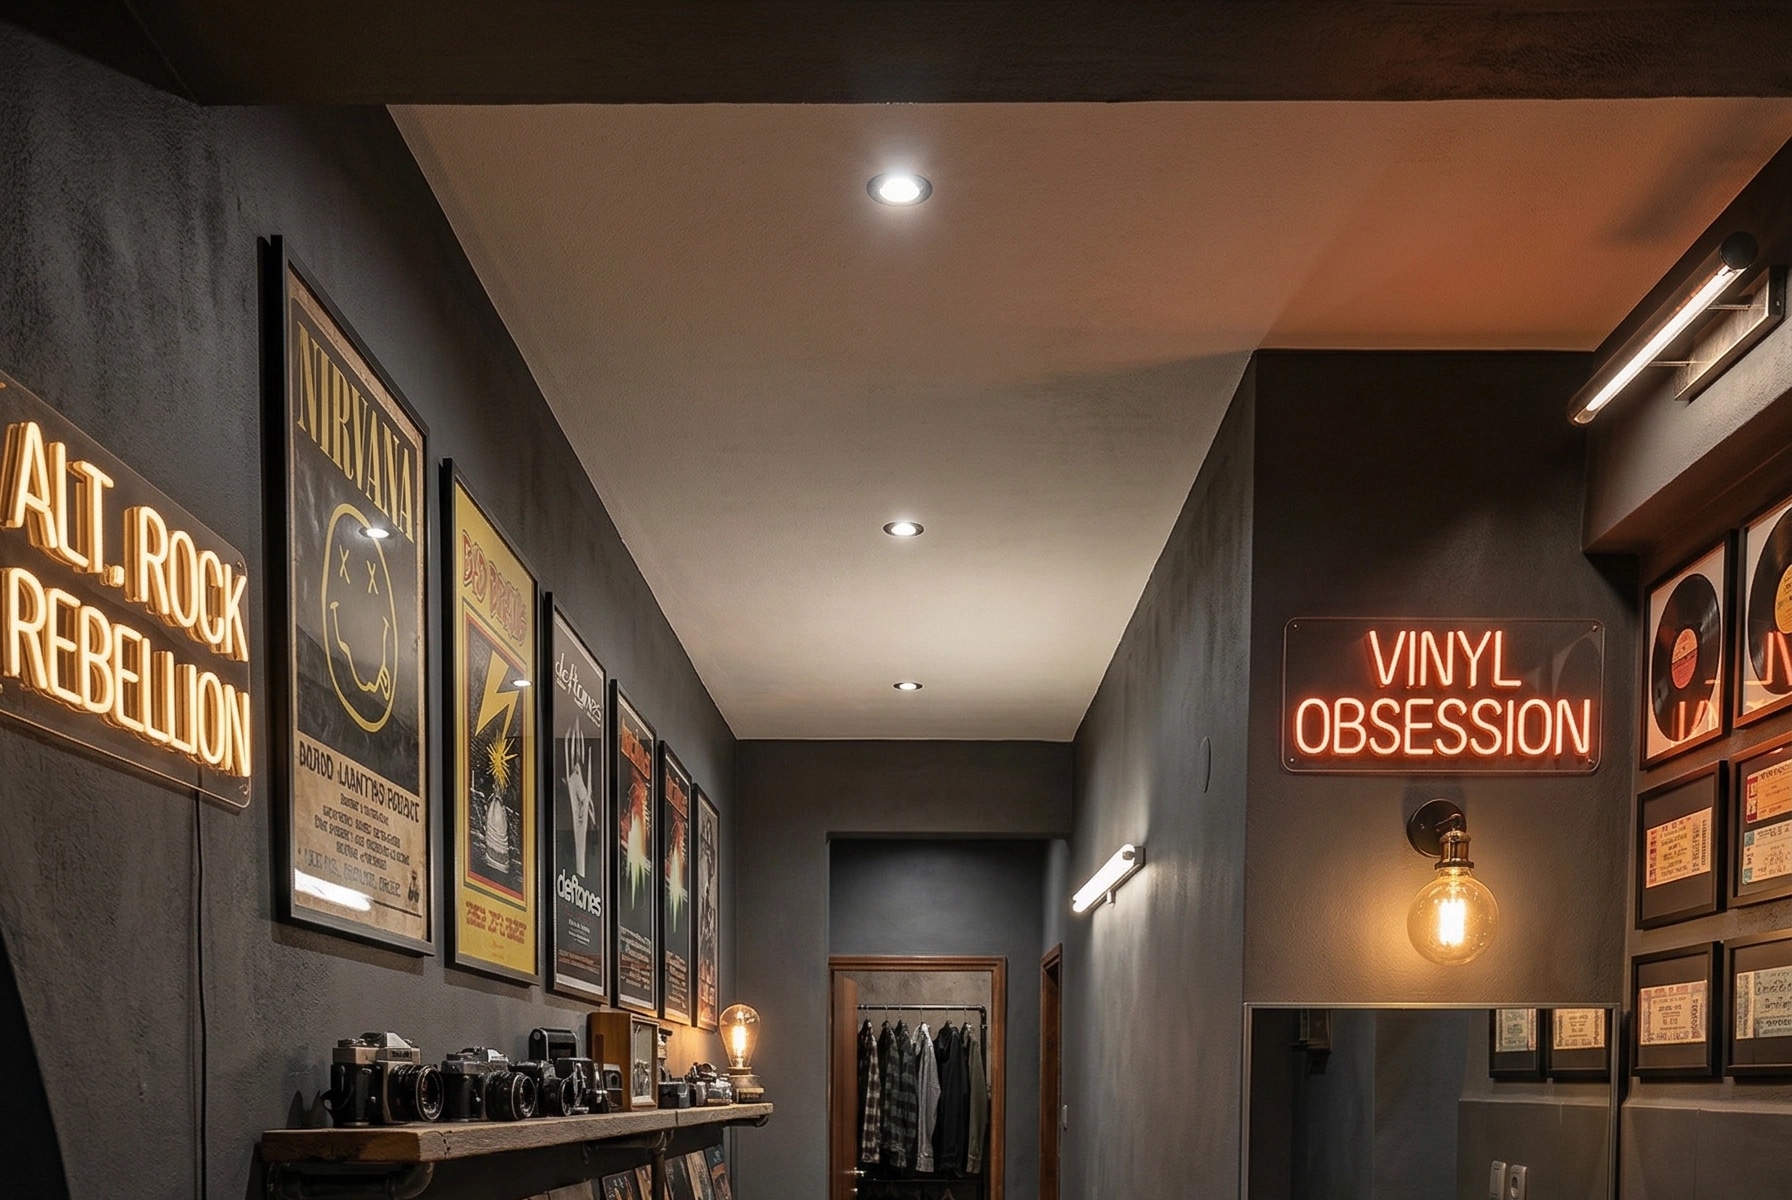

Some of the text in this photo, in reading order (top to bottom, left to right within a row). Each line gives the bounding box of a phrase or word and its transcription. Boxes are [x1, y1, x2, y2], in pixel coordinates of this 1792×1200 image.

[297, 320, 415, 544] NIRVANA
[1, 420, 249, 662] ALT. ROCK
[2, 566, 251, 778] REBELLION
[1368, 629, 1522, 688] VINYL
[1294, 697, 1592, 756] OBSESSION
[556, 868, 602, 917] deftones
